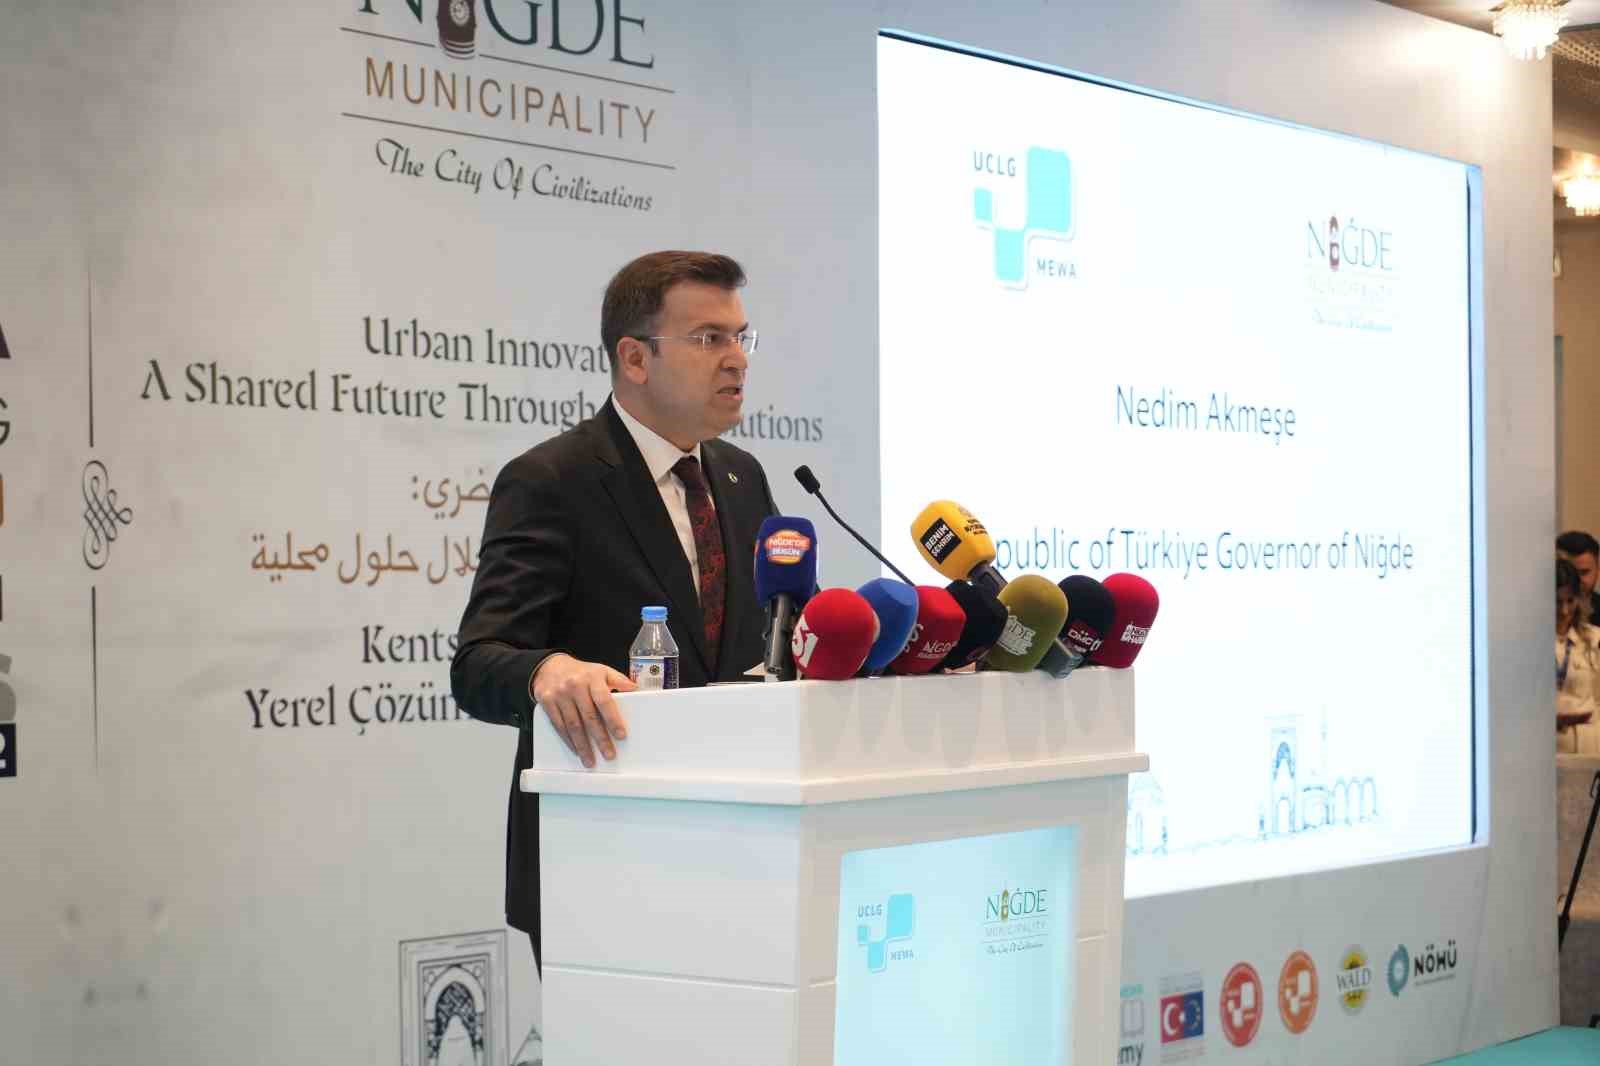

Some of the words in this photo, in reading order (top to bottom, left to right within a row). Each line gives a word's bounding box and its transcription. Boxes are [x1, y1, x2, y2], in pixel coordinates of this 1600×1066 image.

[365, 57, 656, 143] MUNICIPALITY
[375, 138, 424, 178] The
[435, 148, 482, 194] City
[493, 157, 524, 200] Of
[531, 163, 653, 212] Civilizations
[973, 150, 1017, 177] UCLG
[1036, 258, 1077, 278] MEWA
[363, 315, 474, 363] Urban
[486, 328, 608, 374] Innovat
[140, 359, 172, 401] A
[184, 361, 318, 411] Shared
[331, 373, 447, 419] Future
[458, 382, 596, 432] Through
[731, 404, 823, 441] utions
[1116, 384, 1198, 430] Nedim
[1206, 392, 1296, 446] Akmeşe
[411, 467, 490, 519] ضري:
[251, 531, 330, 583] محلية
[338, 532, 419, 586] حلول
[427, 535, 479, 584] لال
[996, 526, 1080, 570] public
[1089, 527, 1115, 570] of
[1121, 529, 1209, 580] Türkiye
[1216, 531, 1321, 570] Governor
[1328, 531, 1350, 570] of
[1355, 532, 1415, 579] Niğde
[362, 624, 458, 663] Kents
[244, 684, 337, 729] Yerel
